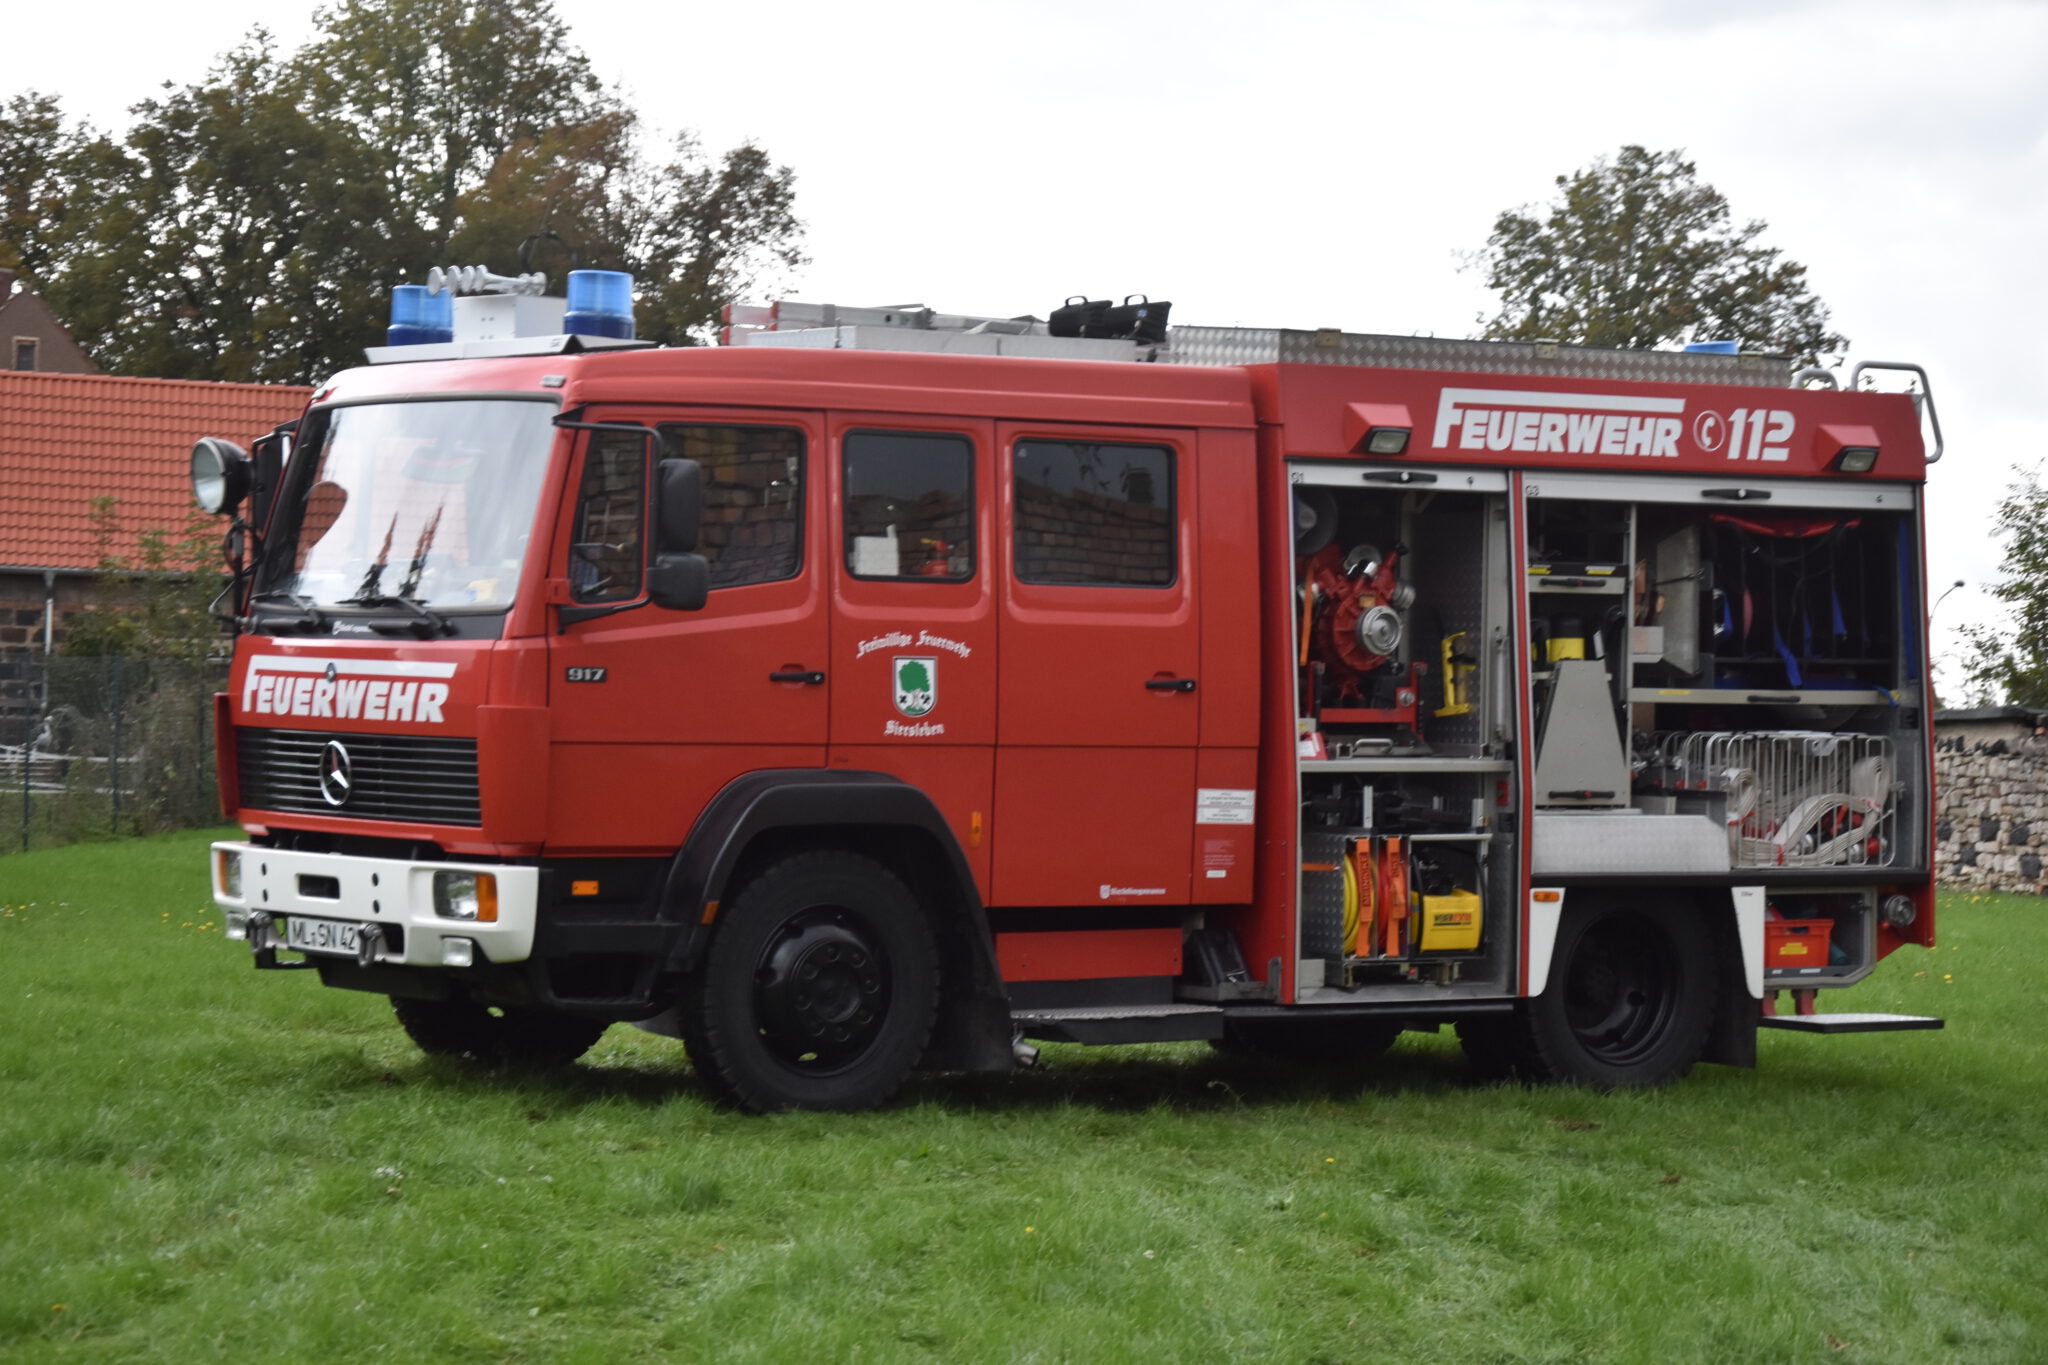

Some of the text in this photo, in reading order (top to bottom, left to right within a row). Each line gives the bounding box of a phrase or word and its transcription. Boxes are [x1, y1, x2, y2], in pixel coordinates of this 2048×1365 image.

[1432, 387, 1796, 462] FEUERWEHR 112
[856, 629, 972, 659] Freiwillige Feuerwehr
[242, 654, 458, 723] FEUERWEHR
[568, 667, 605, 681] 917
